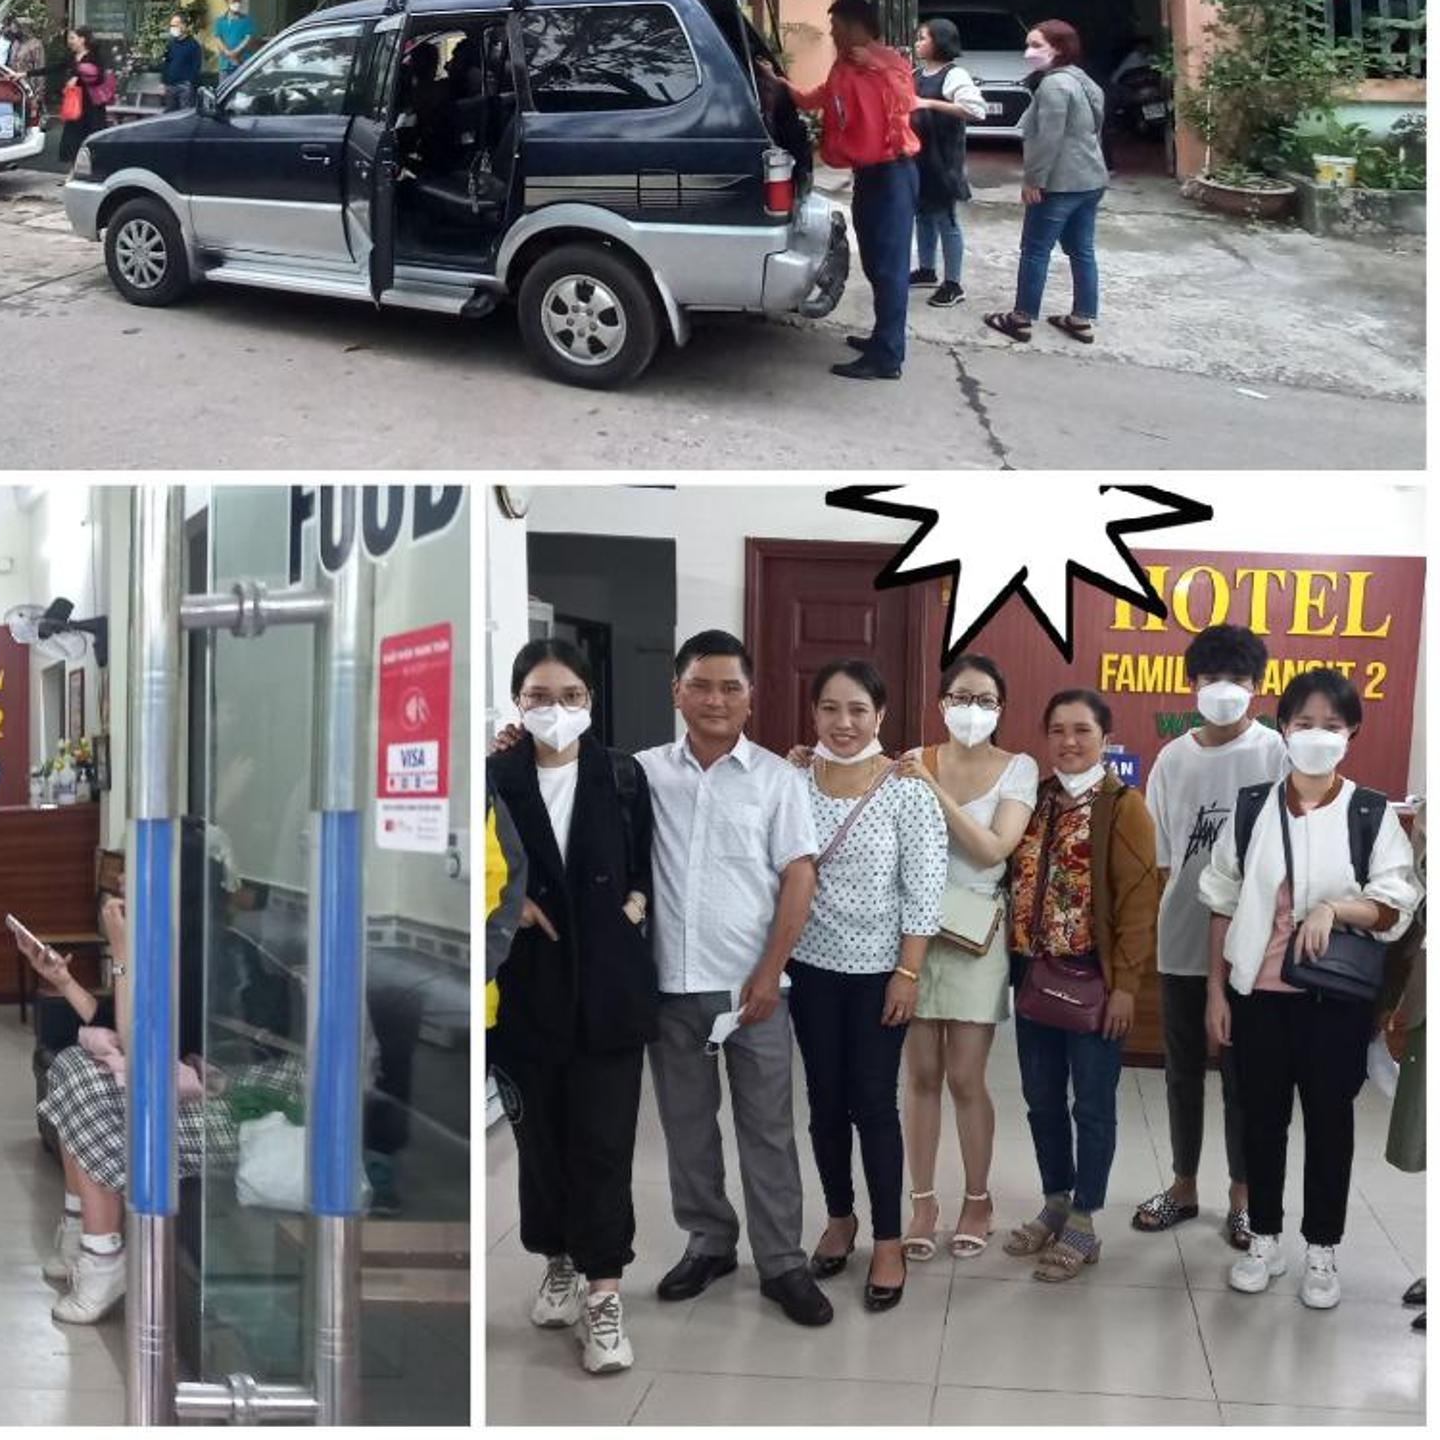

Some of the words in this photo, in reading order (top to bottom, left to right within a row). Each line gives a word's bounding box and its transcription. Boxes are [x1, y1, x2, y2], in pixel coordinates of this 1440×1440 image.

[288, 485, 463, 586] FOOD
[1109, 563, 1392, 637] HOTEL
[1100, 653, 1192, 694] FAMIL
[1363, 661, 1388, 700] 2
[401, 747, 426, 769] VISA
